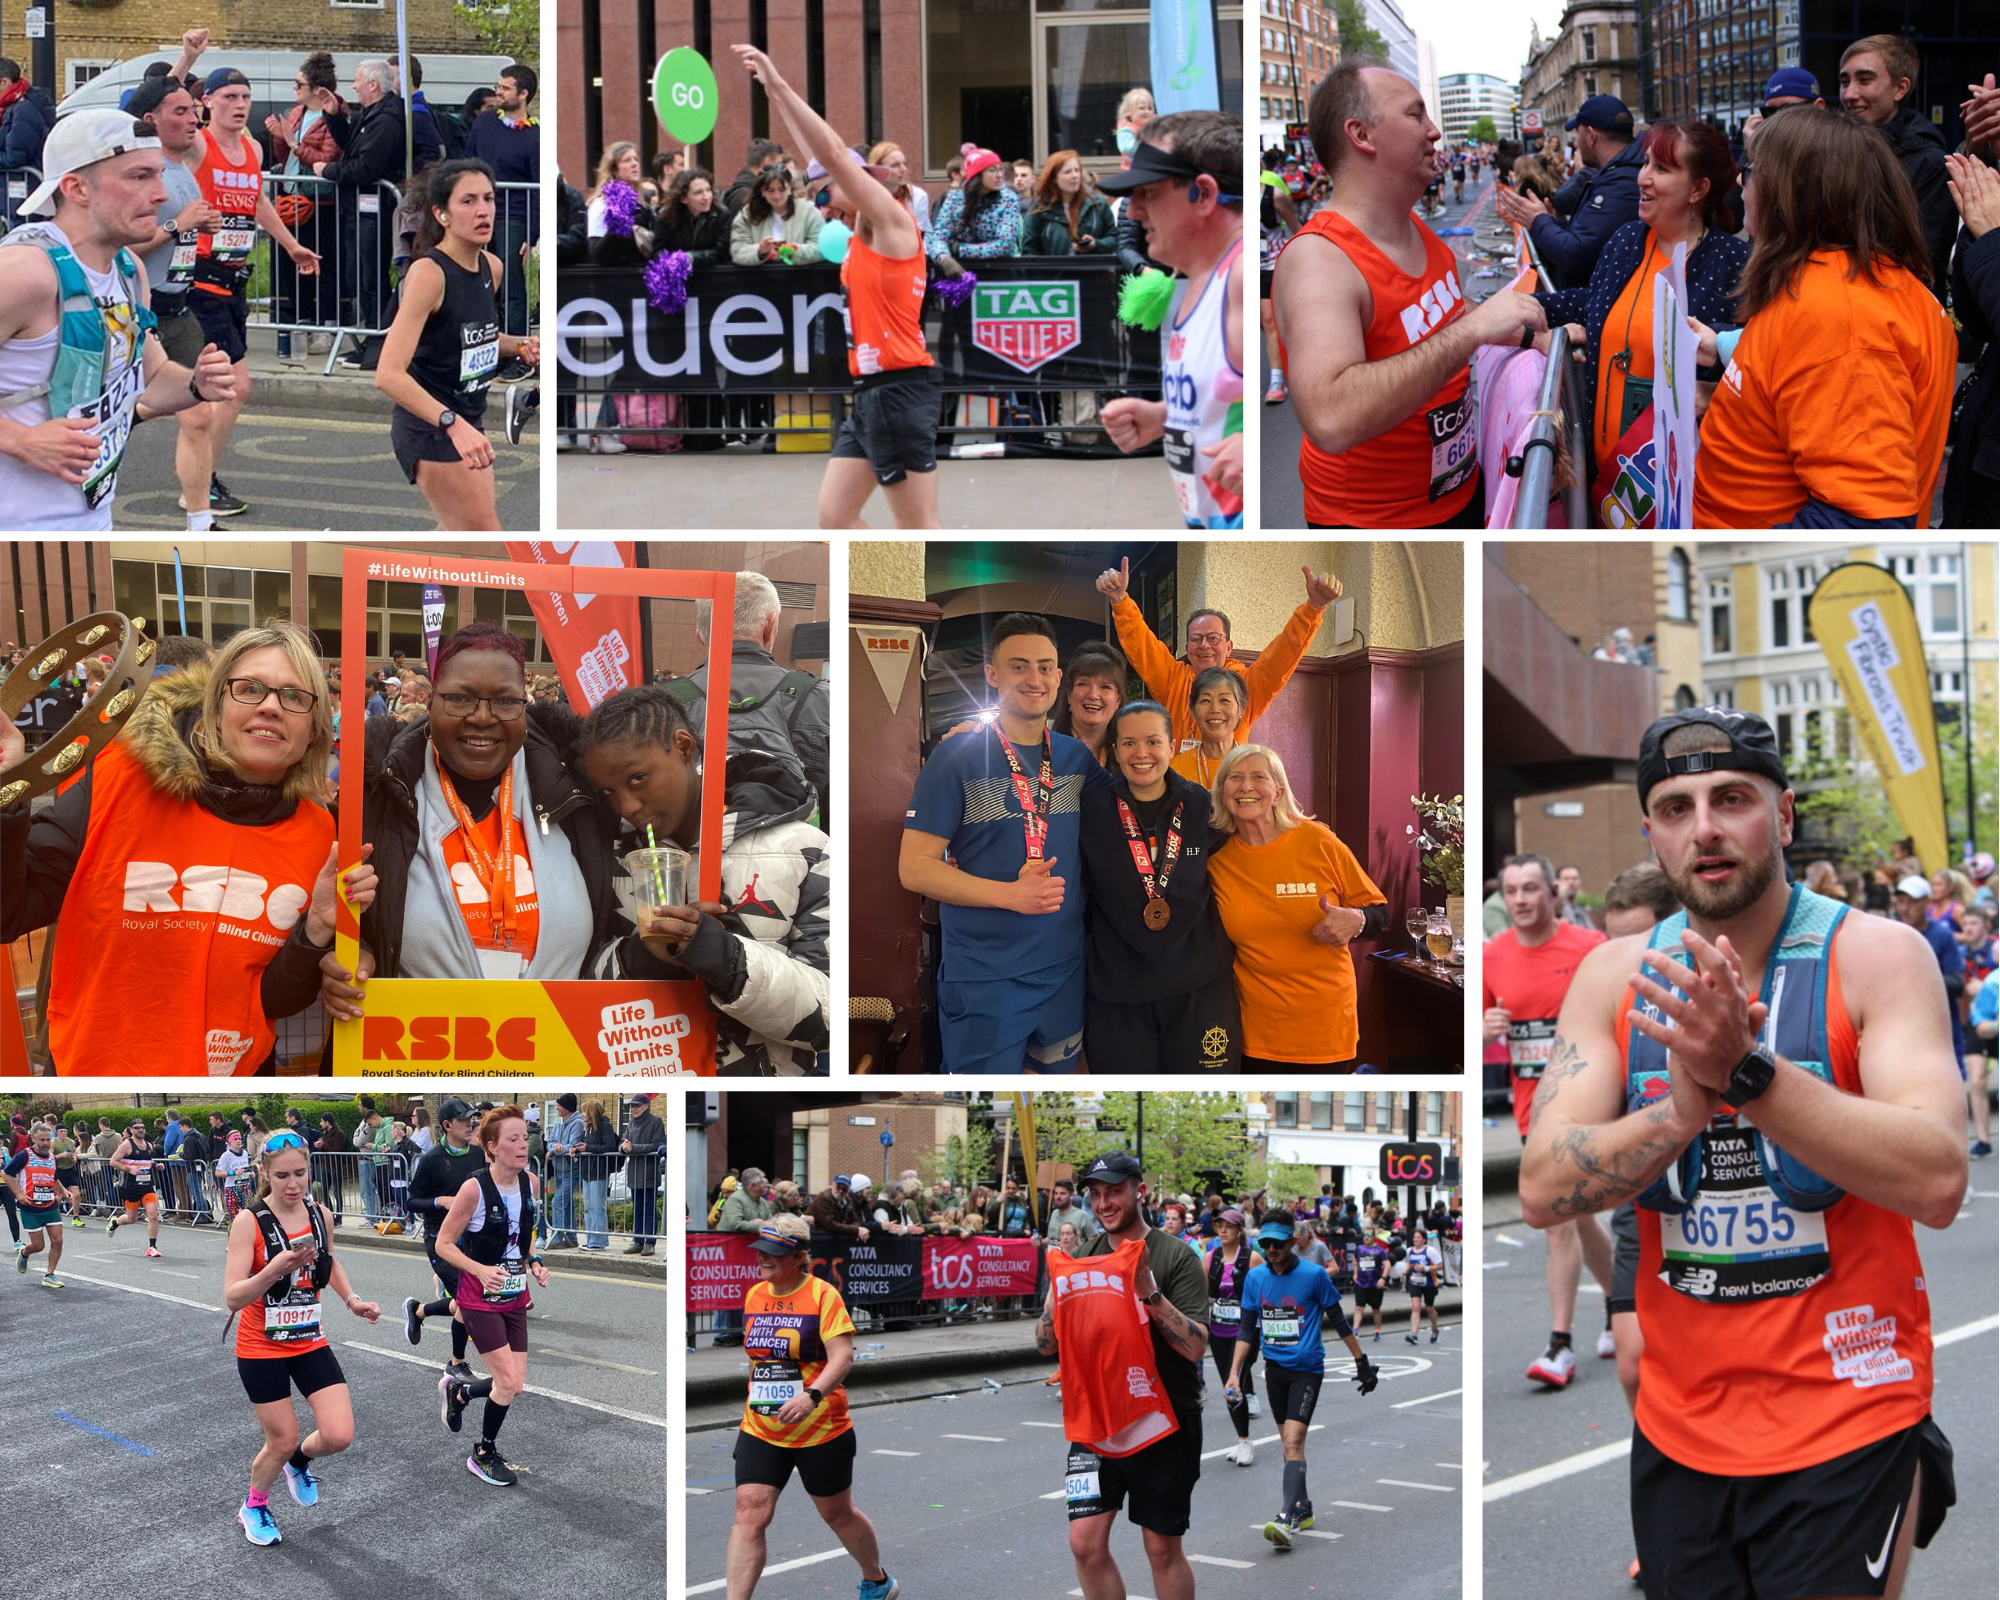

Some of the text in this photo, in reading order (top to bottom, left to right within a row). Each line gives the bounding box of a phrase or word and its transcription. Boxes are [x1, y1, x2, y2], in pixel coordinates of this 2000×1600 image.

[672, 82, 703, 109] GO
[213, 168, 258, 189] RSBC
[216, 192, 256, 207] LEWIS
[981, 288, 1069, 314] TAG
[1399, 269, 1462, 345] RSBC
[463, 328, 485, 345] tcs
[980, 324, 1073, 363] HEUER
[1433, 406, 1465, 437] tcs
[367, 562, 525, 586] #LifeWithoutLimits
[551, 591, 569, 627] dren
[867, 638, 910, 650] RSBC
[1860, 607, 1893, 666] Cystic
[610, 635, 624, 660] Life
[593, 649, 614, 687] Limits
[601, 637, 624, 687] Without
[583, 656, 605, 694] For Blind
[1853, 641, 1889, 714] Fibrosis
[1888, 712, 1917, 768] Trust
[1004, 749, 1021, 773] 2024
[1041, 760, 1051, 783] 2024
[1166, 835, 1179, 859] 2024
[123, 861, 308, 931] RSBC
[1276, 883, 1317, 895] RSBC
[122, 918, 286, 947] Royal Society Blind Childre
[611, 1006, 645, 1025] Life
[211, 1033, 232, 1044] Life
[362, 1016, 536, 1062] RSBC
[604, 1018, 684, 1047] Without
[614, 1042, 674, 1066] Limits
[362, 1069, 535, 1077] Royal Society for Blind Children
[1709, 1138, 1747, 1151] TATA
[1387, 1149, 1434, 1179] tcs
[1681, 1200, 1795, 1247] 66755
[690, 1246, 725, 1260] TATA
[850, 1246, 877, 1260] TATA
[977, 1245, 1004, 1257] TATA
[690, 1264, 762, 1281] CONSULTANC
[808, 1257, 844, 1293] cs
[849, 1263, 913, 1278] CONSULTANCY
[931, 1247, 974, 1290] tcs
[977, 1260, 1031, 1273] CONSULTANCY
[690, 1284, 742, 1300] SERVICES
[848, 1281, 890, 1295] SERVICES
[976, 1275, 1011, 1288] SERVICES
[1055, 1270, 1125, 1298] RSBC
[1719, 1275, 1816, 1297] new balance
[275, 1308, 314, 1324] 10917
[764, 1301, 794, 1312] LISA
[753, 1316, 803, 1328] CHILDREN
[1835, 1311, 1868, 1329] Life
[749, 1327, 773, 1337] WITH
[1829, 1319, 1893, 1348] Without
[746, 1338, 788, 1349] CANCER
[773, 1349, 788, 1359] UK
[1863, 1352, 1895, 1371] Blind
[754, 1366, 770, 1379] tcs
[757, 1385, 795, 1399] 71059
